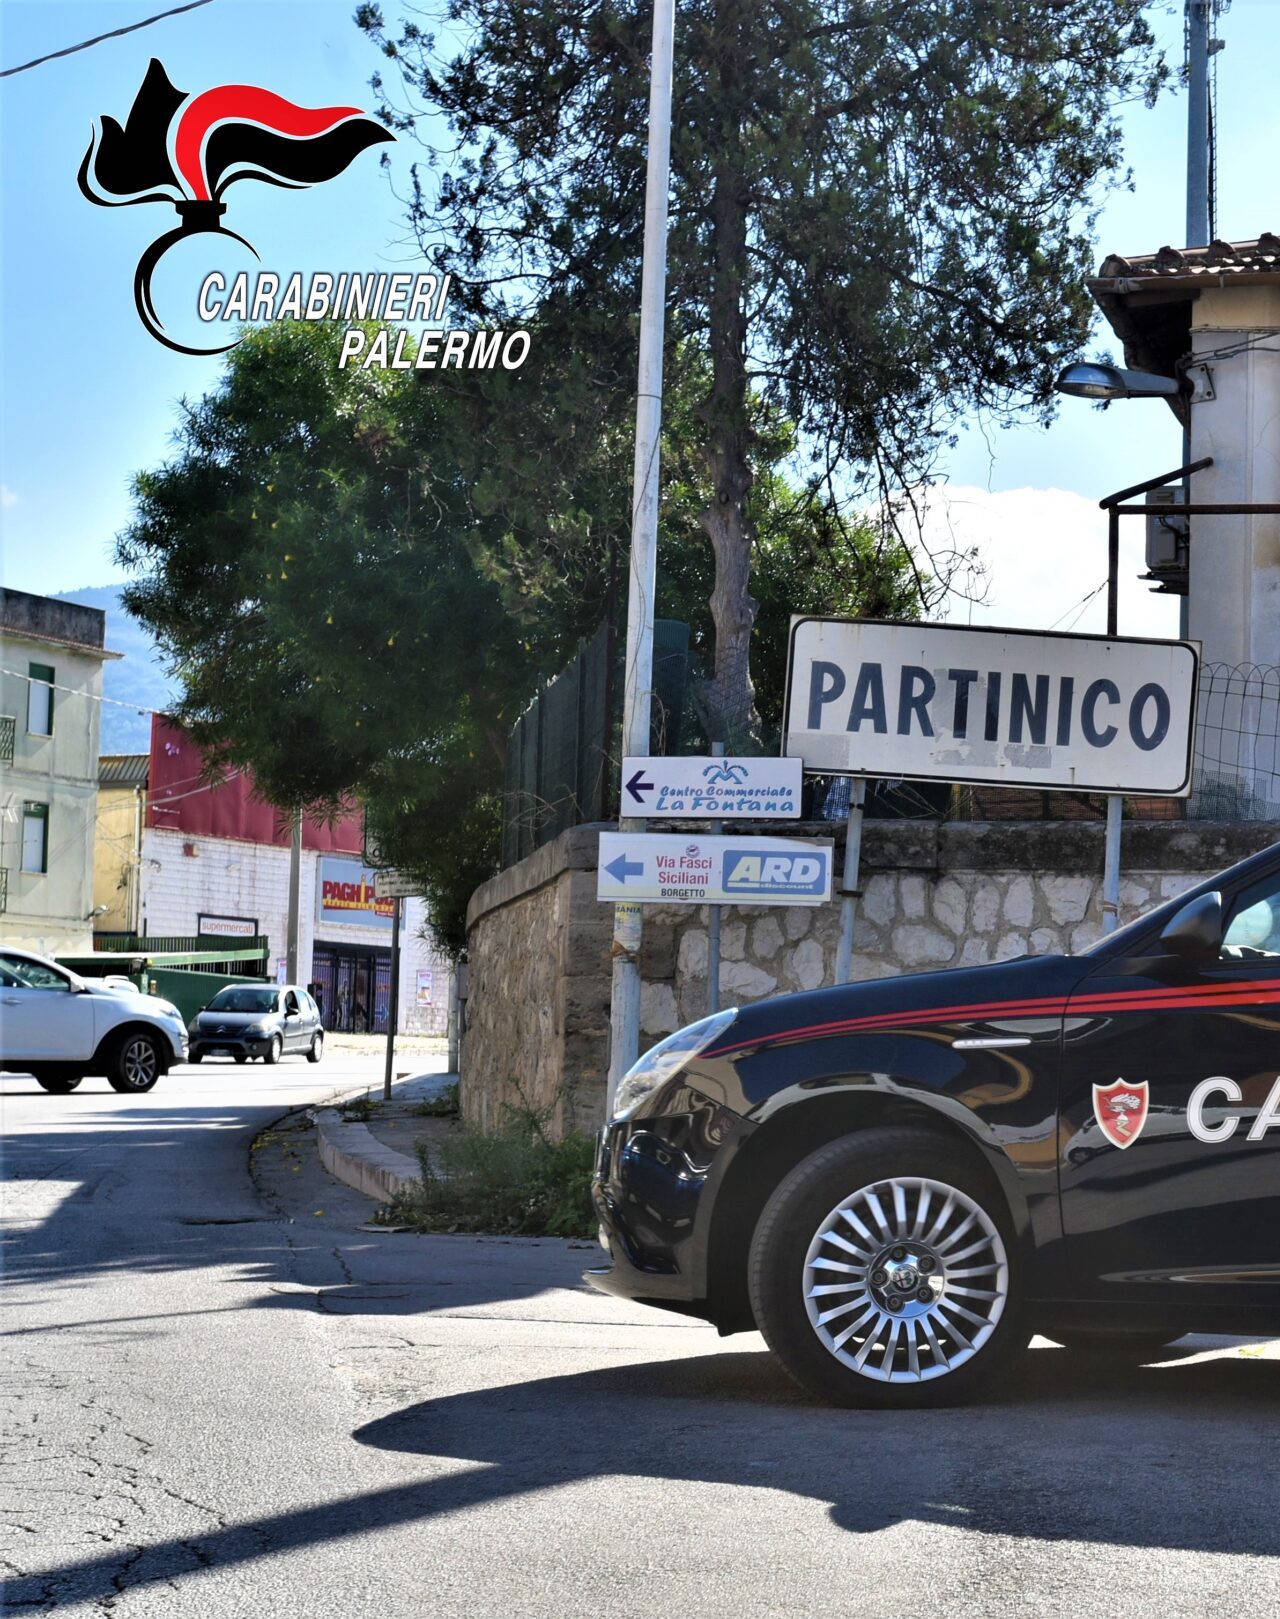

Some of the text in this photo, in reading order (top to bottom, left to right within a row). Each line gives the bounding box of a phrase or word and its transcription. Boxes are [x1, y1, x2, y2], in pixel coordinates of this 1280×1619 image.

[806, 660, 1171, 752] PARTINICO
[660, 785, 793, 797] Centro Commerciale
[656, 797, 794, 812] La Fontana
[656, 856, 713, 870] Via Fasci
[728, 856, 821, 883] ARD
[658, 872, 709, 885] Siciliani
[760, 882, 814, 890] discount
[660, 888, 706, 898] BORGETTO
[202, 921, 254, 934] supermercati
